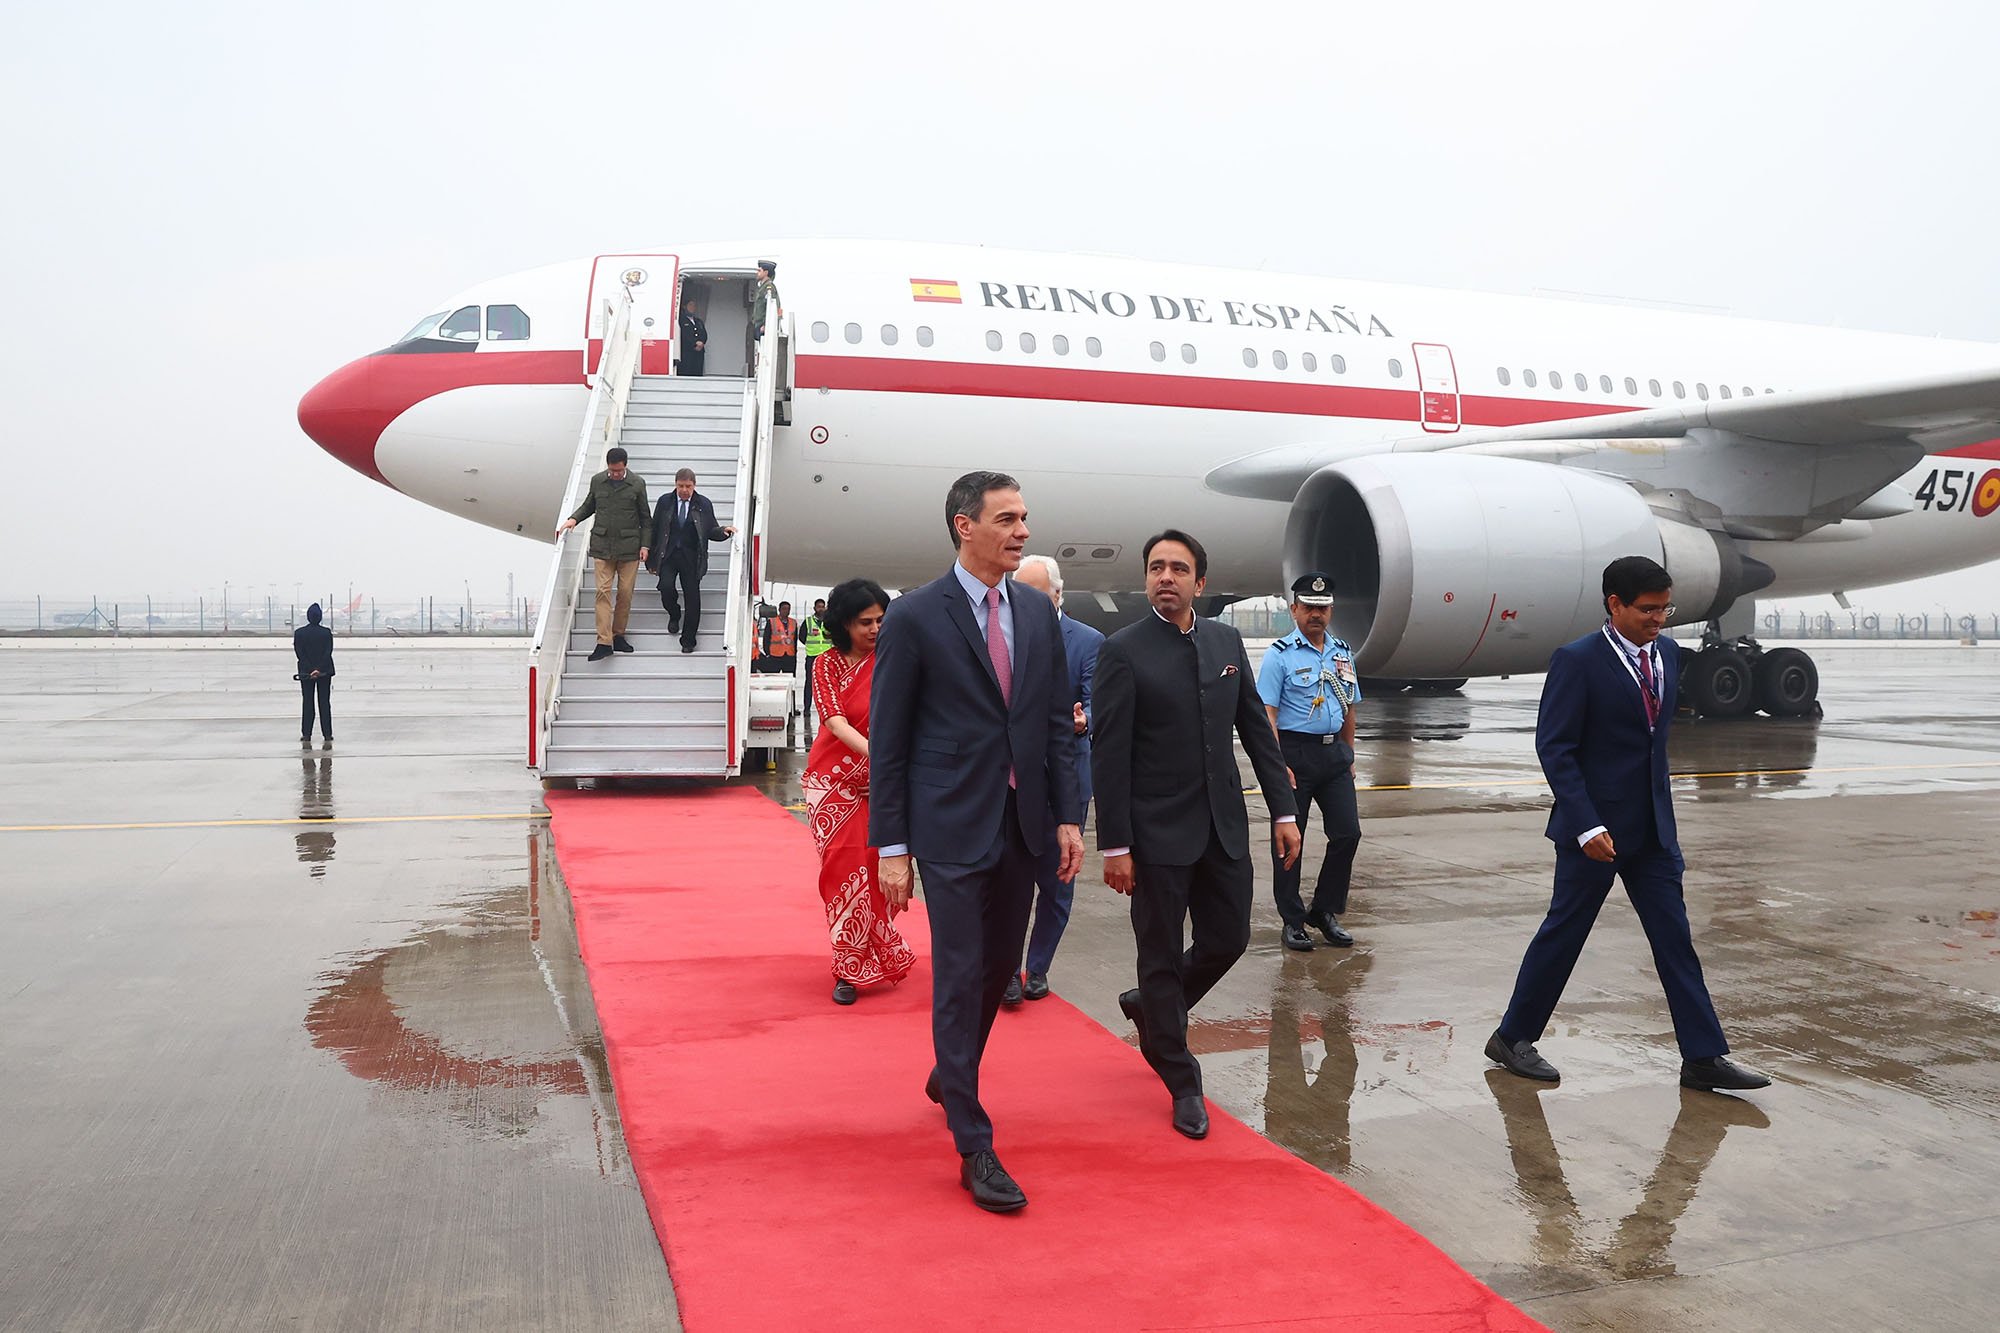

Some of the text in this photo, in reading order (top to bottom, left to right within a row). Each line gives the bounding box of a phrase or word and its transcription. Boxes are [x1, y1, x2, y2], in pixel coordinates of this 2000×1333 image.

[978, 281, 1395, 338] REINO DE ESPAÑA
[1915, 469, 1974, 512] 451
